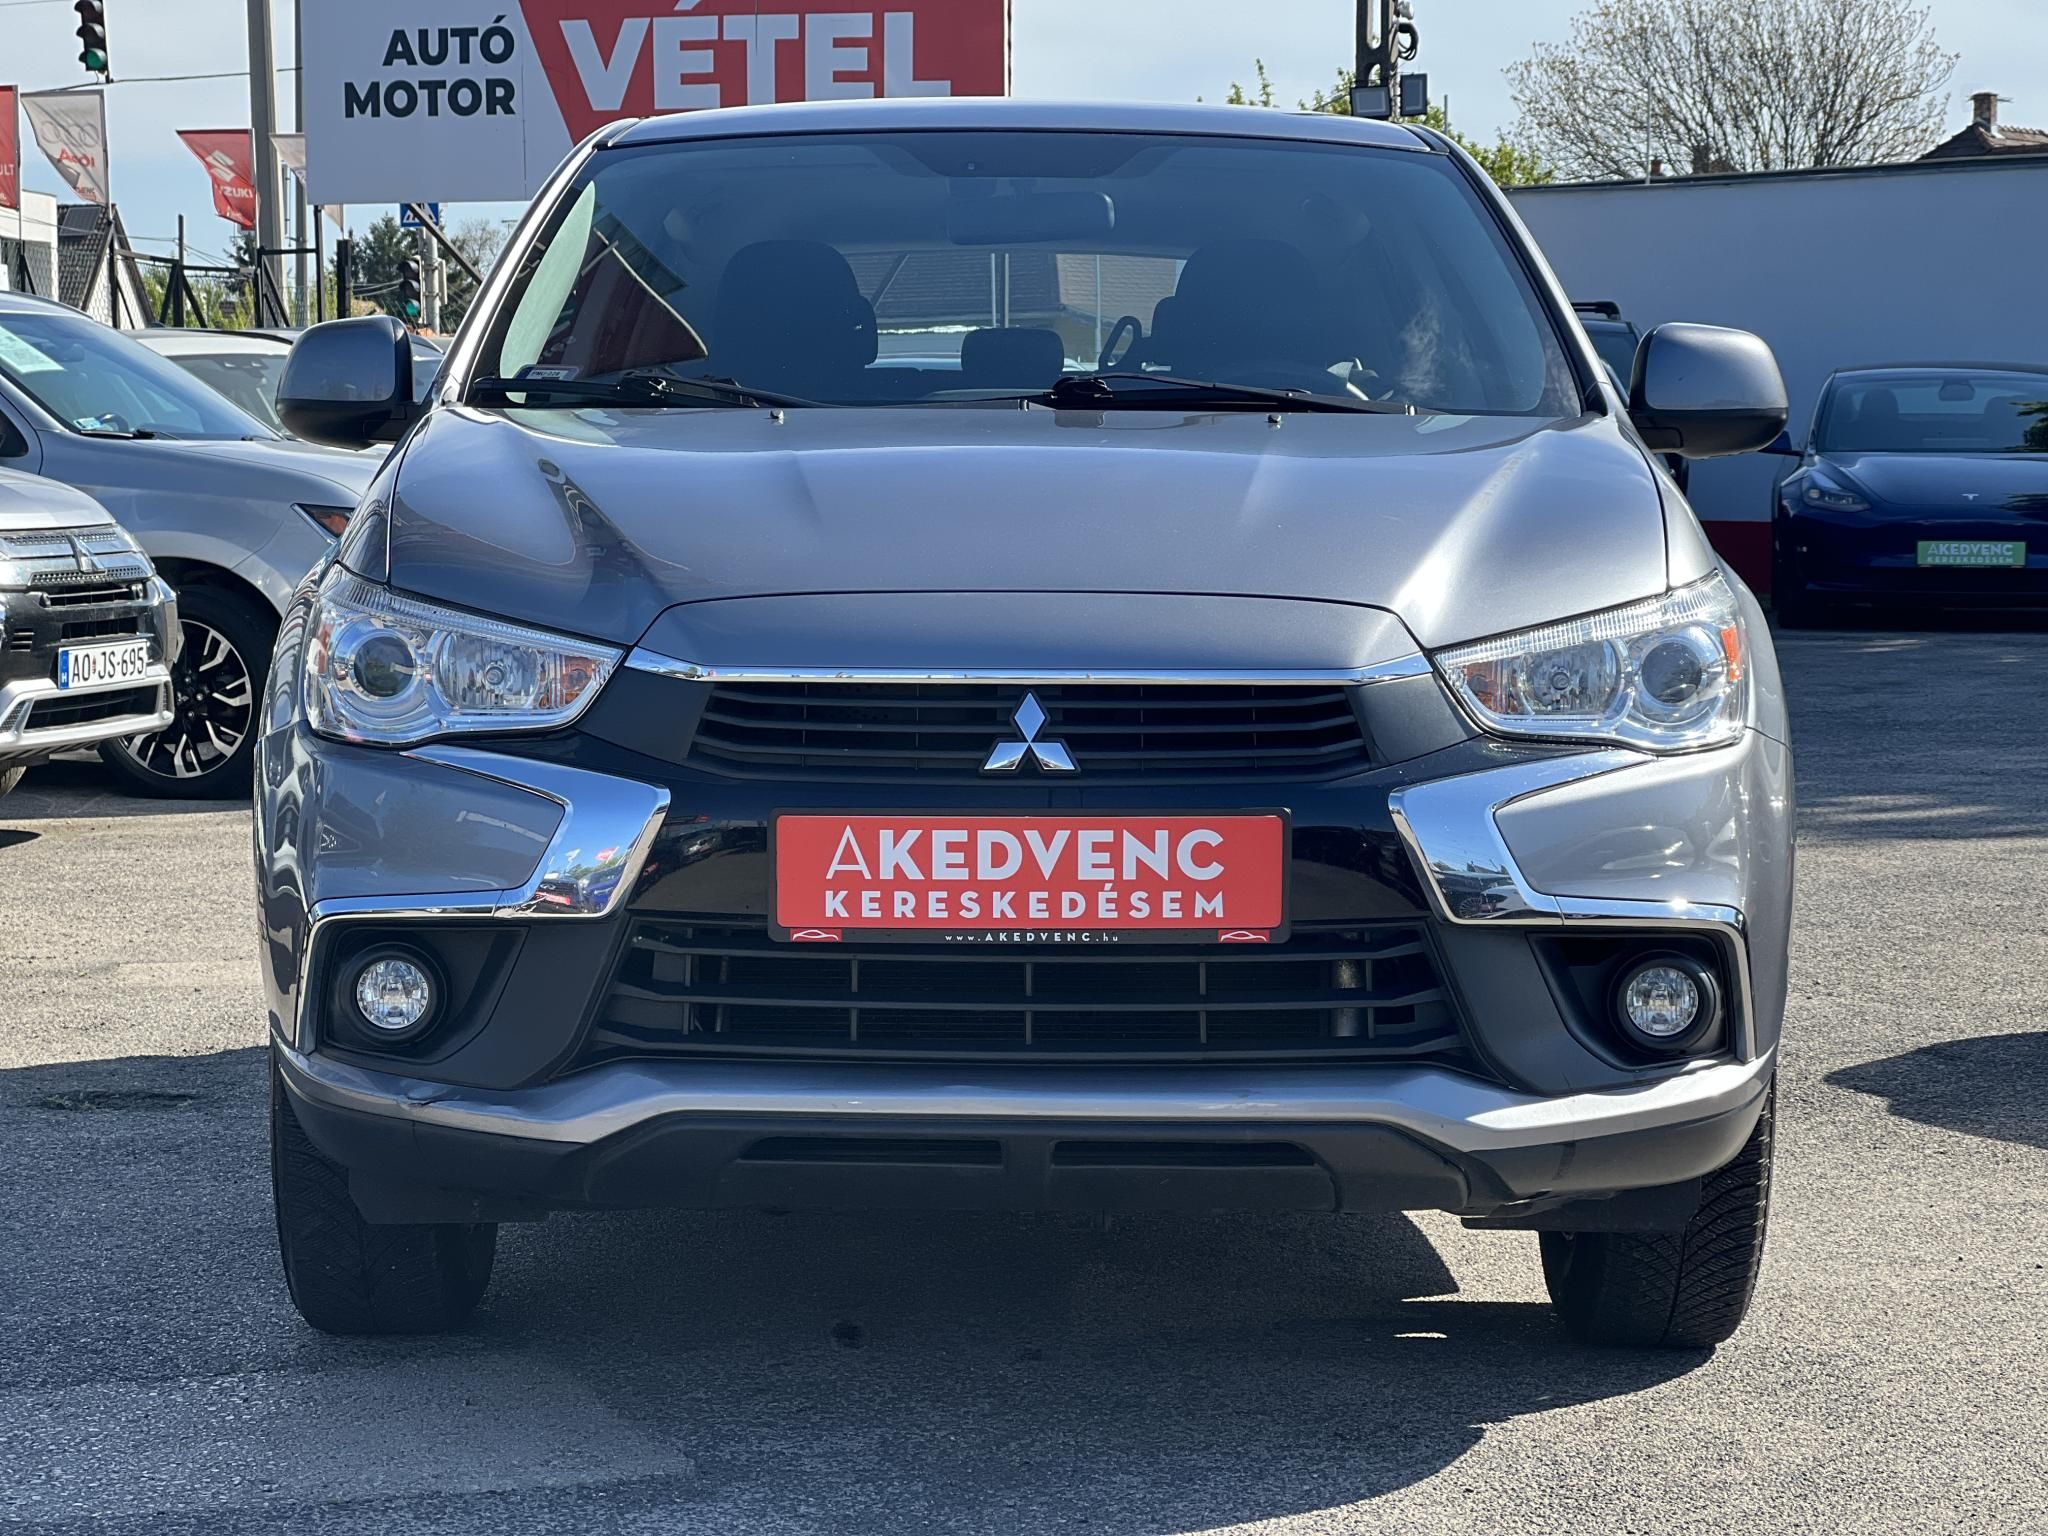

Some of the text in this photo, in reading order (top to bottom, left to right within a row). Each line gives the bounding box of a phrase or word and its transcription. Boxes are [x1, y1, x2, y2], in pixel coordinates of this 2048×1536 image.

[382, 15, 514, 66] AUTÓ
[559, 0, 951, 111] VÉTEL
[344, 78, 516, 118] MOTOR
[1927, 543, 2013, 556] AKEDVENC
[825, 824, 1225, 881] AKEDVENC
[825, 883, 1225, 918] KERESKEDÉSEM
[945, 932, 1118, 942] www.AKEDVENC.hu
